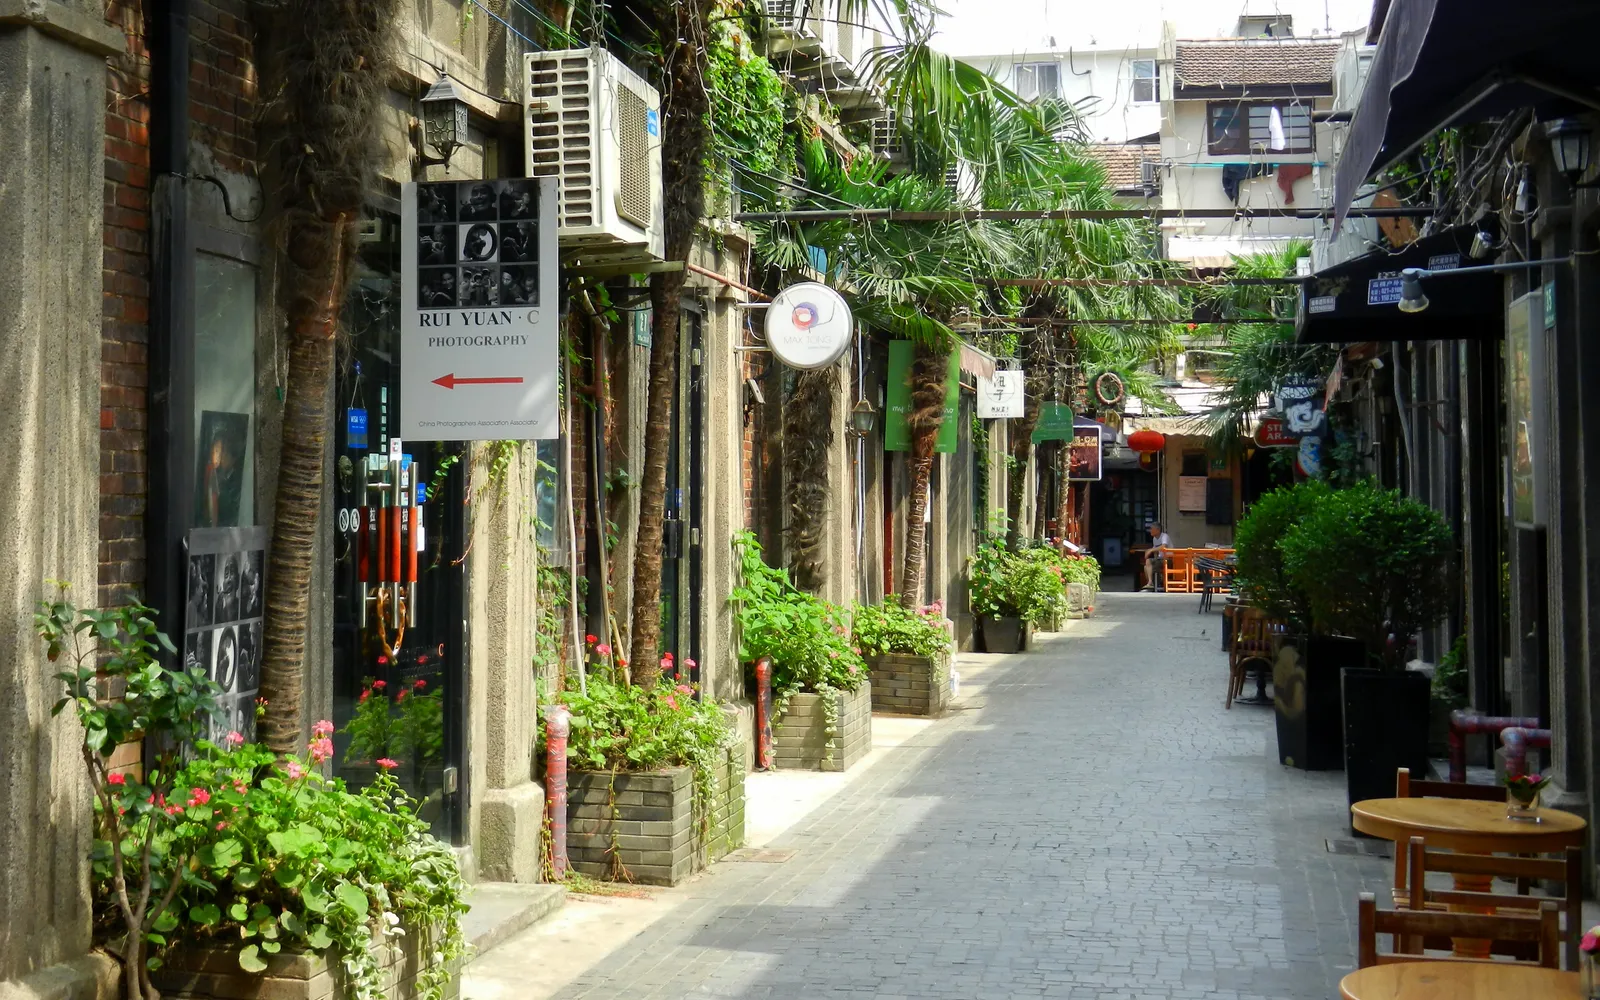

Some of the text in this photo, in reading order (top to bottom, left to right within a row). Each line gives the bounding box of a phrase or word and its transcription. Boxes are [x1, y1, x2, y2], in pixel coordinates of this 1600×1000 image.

[420, 312, 451, 327] RUI
[461, 311, 512, 326] YUAN
[428, 335, 529, 347] PHOTOGRAPHY
[783, 335, 803, 344] MAX
[436, 420, 477, 428] Photographers
